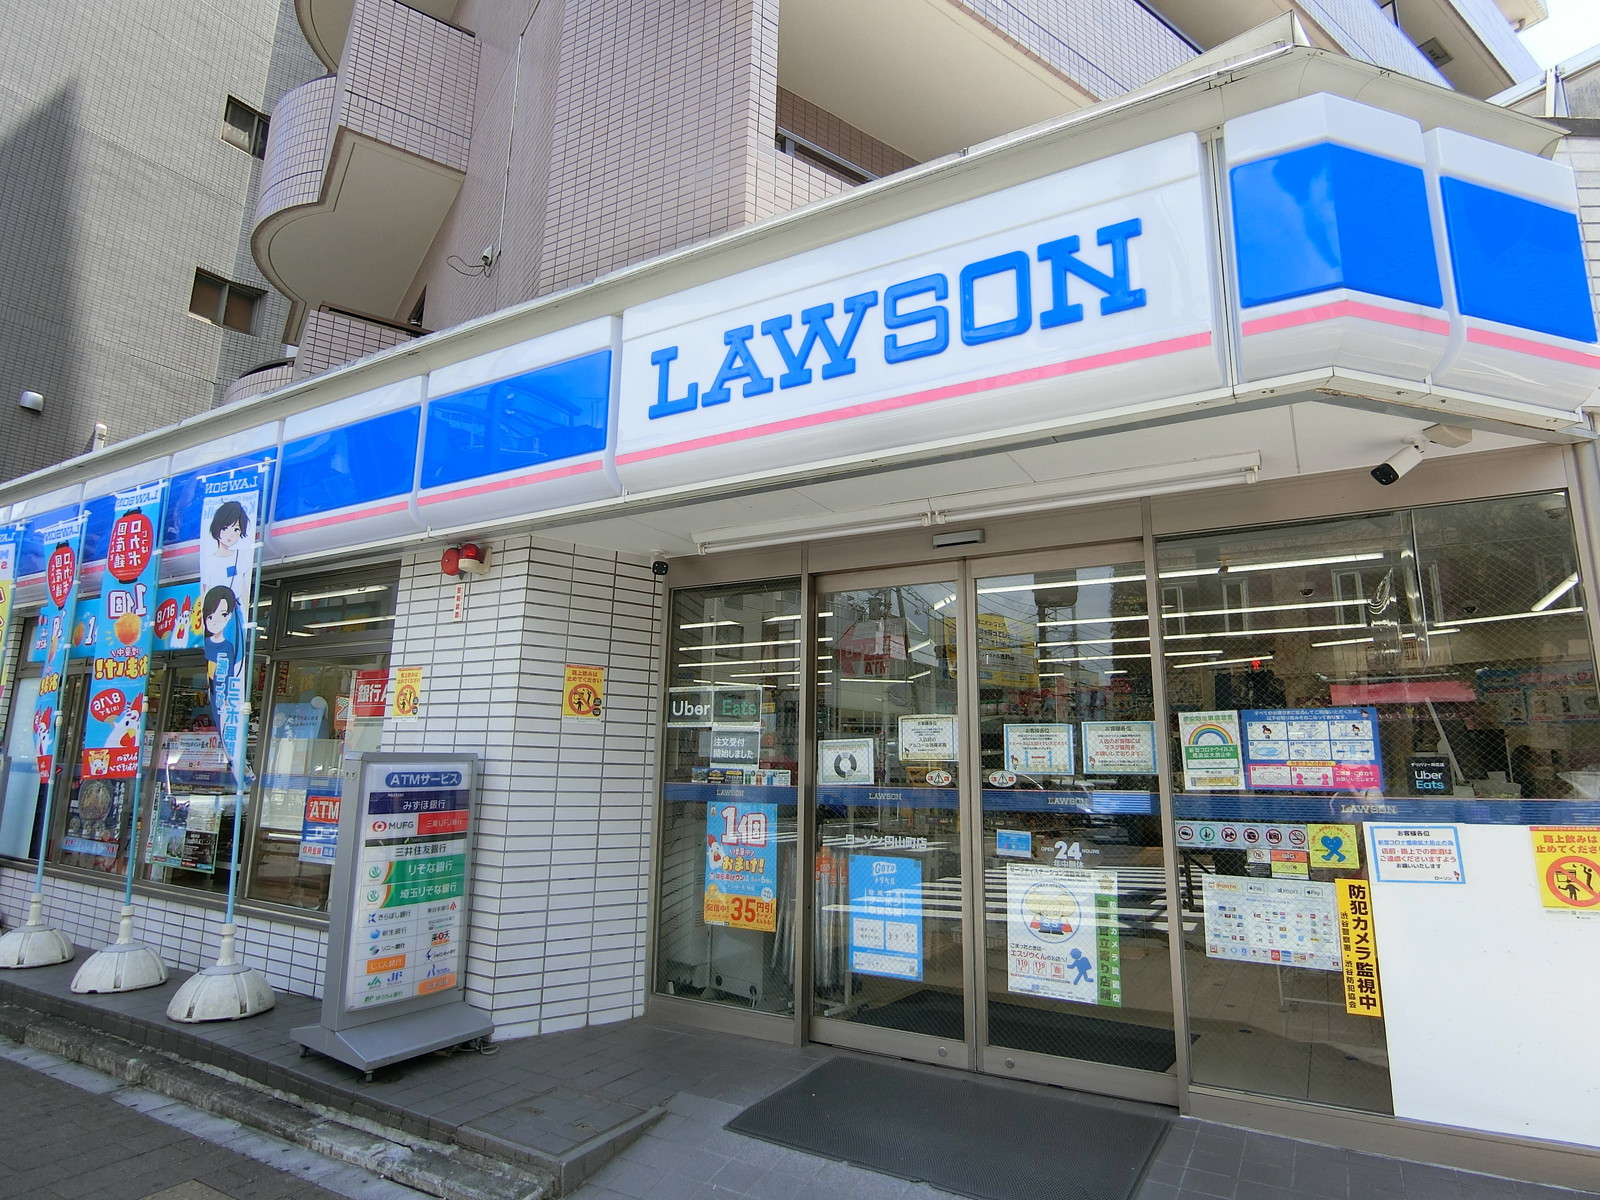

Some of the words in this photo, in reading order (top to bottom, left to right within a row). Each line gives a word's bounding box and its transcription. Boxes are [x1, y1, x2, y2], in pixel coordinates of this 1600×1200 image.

[648, 217, 1146, 420] LAWSON
[567, 675, 602, 684] 止めてください
[672, 700, 711, 716] Uber
[722, 699, 757, 716] Eats
[713, 738, 745, 747] 注文受付
[713, 750, 754, 760] 開始しました
[390, 773, 459, 786] ATMサービス
[1414, 770, 1443, 780] Uber
[1415, 780, 1445, 789] Eats
[869, 792, 902, 800] LAWSON
[1047, 797, 1089, 805] LAWSON
[310, 800, 340, 820] ATM
[402, 799, 446, 811] みずほ銀行
[1340, 804, 1397, 815] LAWSON
[388, 821, 414, 831] MUFG
[425, 818, 463, 829] 三菱UFJ銀行
[721, 806, 768, 847] 1個
[845, 834, 928, 850] ローソン円山町店
[1543, 834, 1599, 844] 路上飲みは
[395, 843, 447, 857] 三井住友銀行
[1054, 840, 1082, 860] 24
[1381, 847, 1453, 855] 店前・路上での飲酒は
[1053, 860, 1085, 869] 年中無休
[1380, 855, 1457, 863] ご遠慮くださいますよう
[408, 860, 454, 876] りそな銀行
[722, 856, 766, 875] おまけ!
[400, 882, 458, 899] 埼玉りそな銀行
[378, 910, 412, 921] きらぼし銀行
[731, 897, 756, 924] 35
[382, 927, 408, 936] 新生銀行
[1348, 884, 1377, 1011] 防犯カメラ監視中
[1017, 959, 1028, 967] 110
[1340, 911, 1357, 1009] 渋谷警察署・渋谷防犯協会
